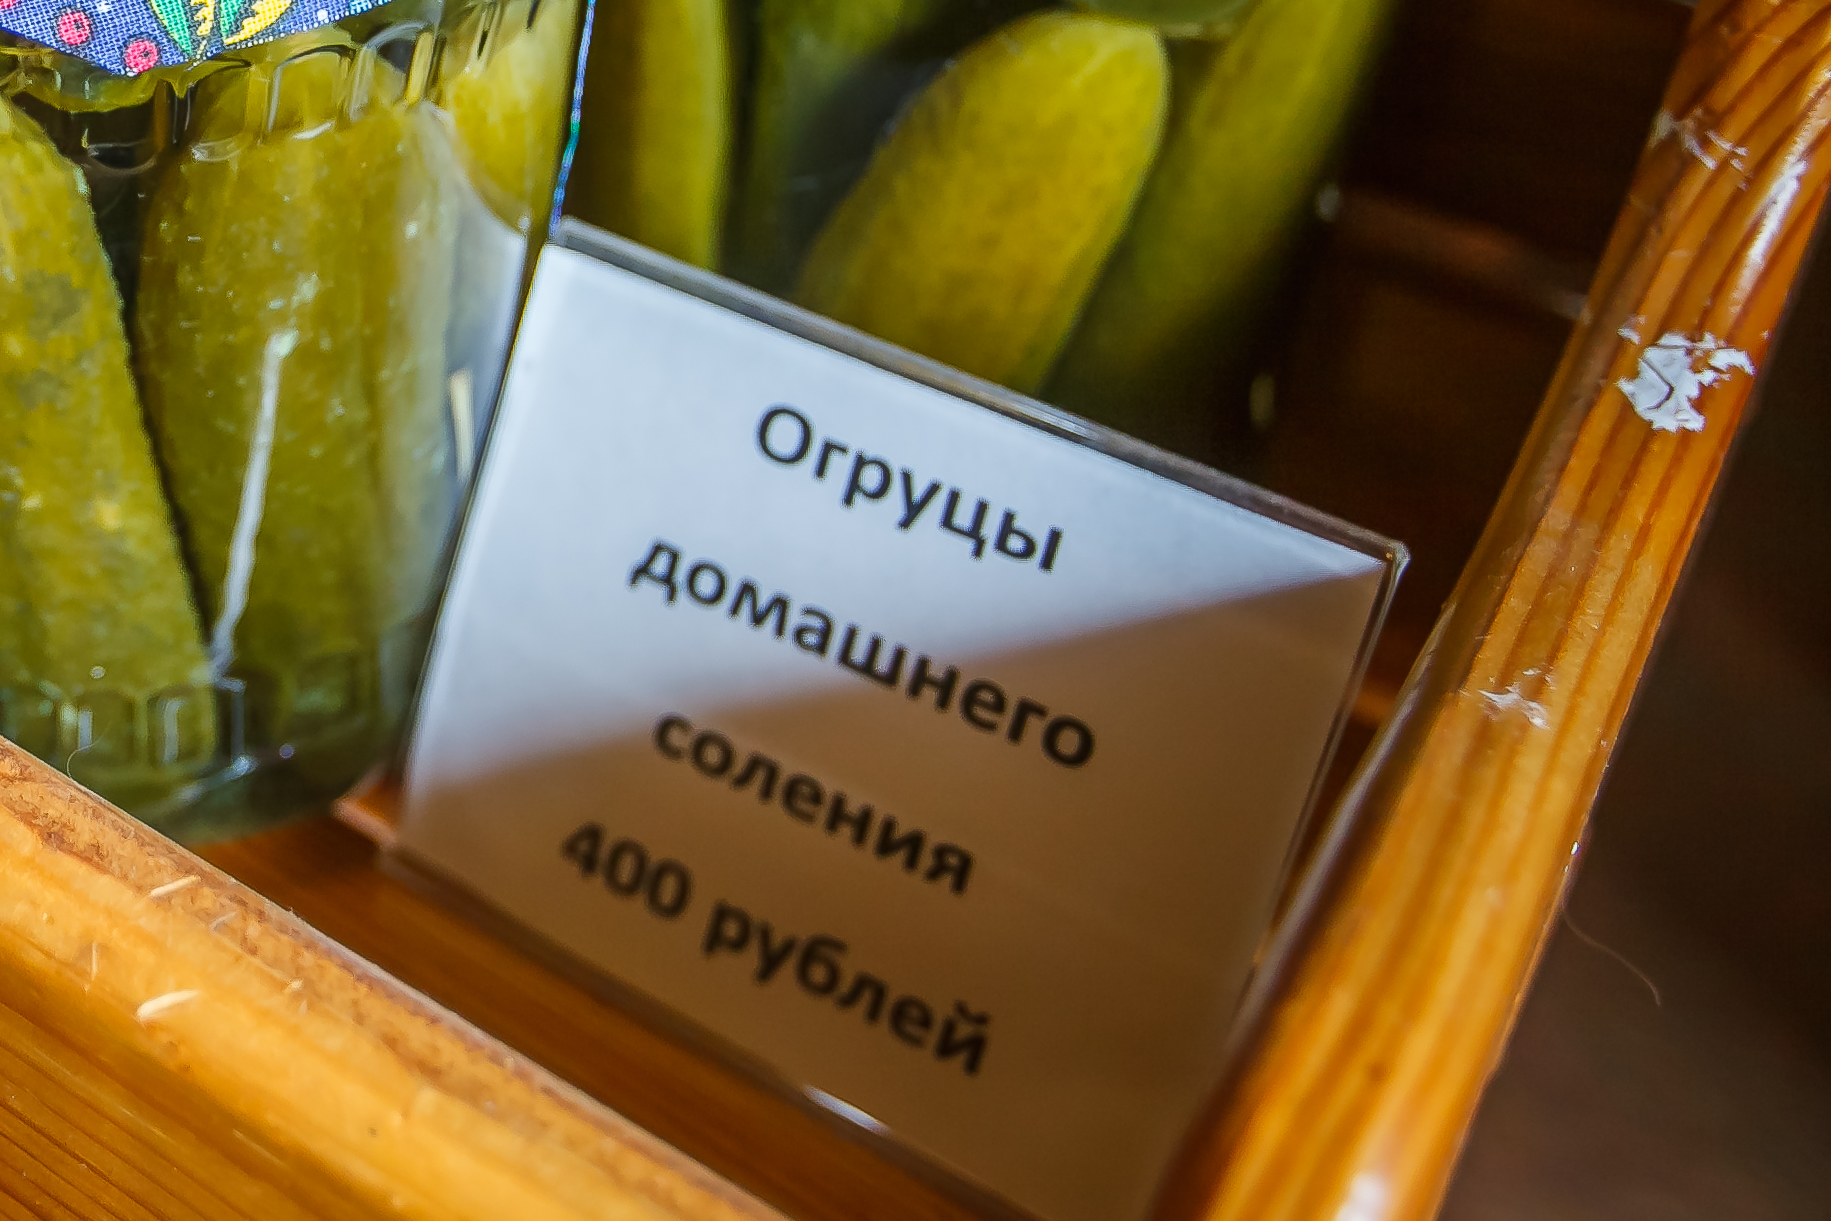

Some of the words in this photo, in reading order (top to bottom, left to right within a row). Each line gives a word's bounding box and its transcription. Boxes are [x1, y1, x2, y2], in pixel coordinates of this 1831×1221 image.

[756, 403, 1063, 572] Огруцы
[629, 538, 1097, 770] домашнего
[651, 712, 976, 896] соления
[561, 819, 694, 919] 400
[701, 894, 991, 1076] рублей
